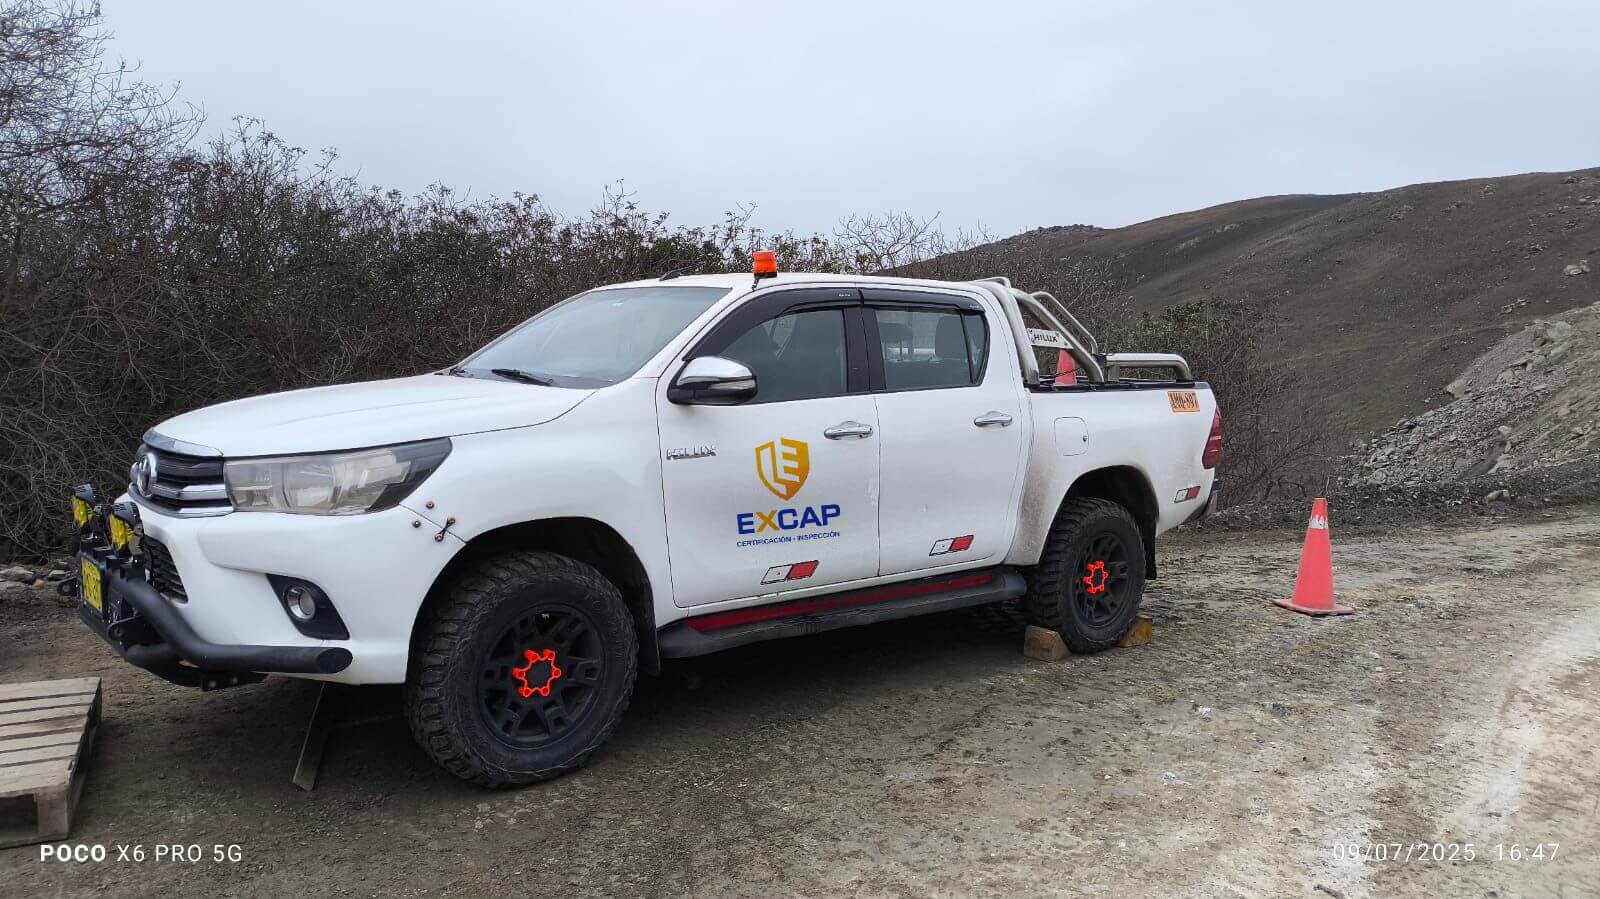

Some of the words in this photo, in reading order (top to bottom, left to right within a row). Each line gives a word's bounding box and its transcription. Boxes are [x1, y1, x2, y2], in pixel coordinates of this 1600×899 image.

[1033, 333, 1058, 343] HILUX
[736, 504, 841, 535] EXCAP
[736, 536, 792, 548] CERTIFICACIÓN
[797, 530, 841, 541] INSPECCIÓN
